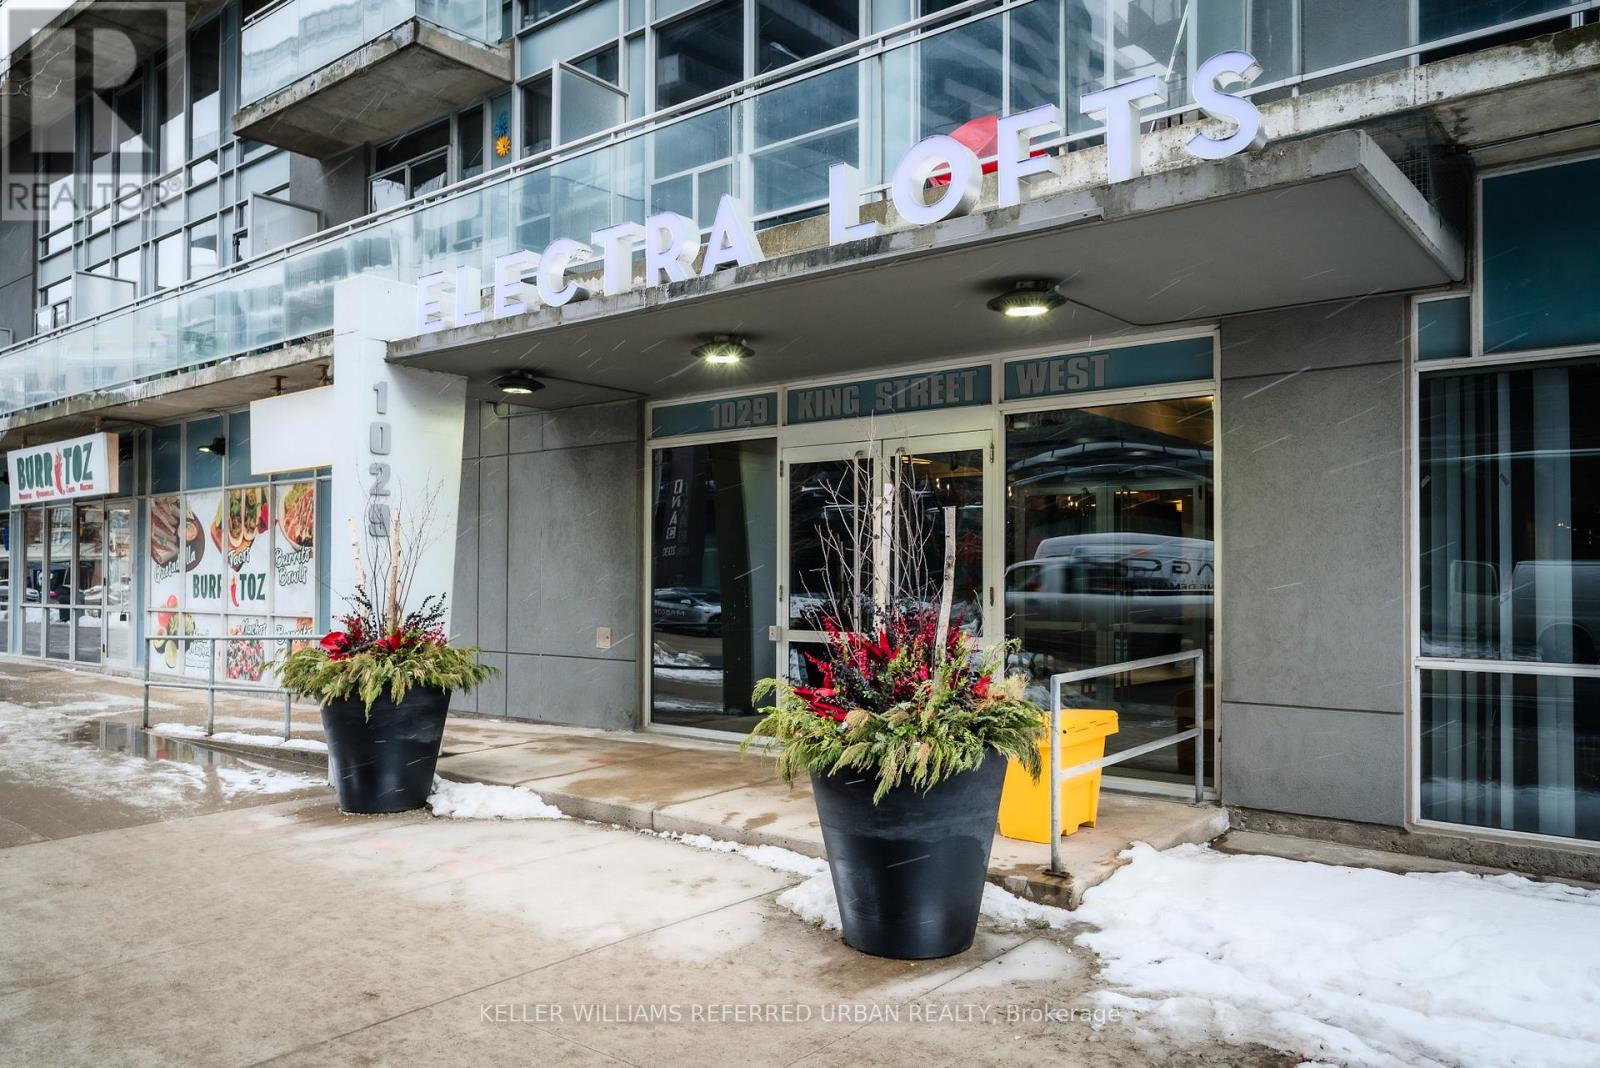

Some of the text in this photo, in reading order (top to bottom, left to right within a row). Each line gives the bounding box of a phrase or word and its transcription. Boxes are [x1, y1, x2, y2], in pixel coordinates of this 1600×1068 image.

[417, 49, 1264, 335] ELECTRA LOFTS
[711, 354, 1109, 430] 1029 KING STREET WEST
[369, 381, 392, 537] 1029
[278, 563, 308, 586] Bowls
